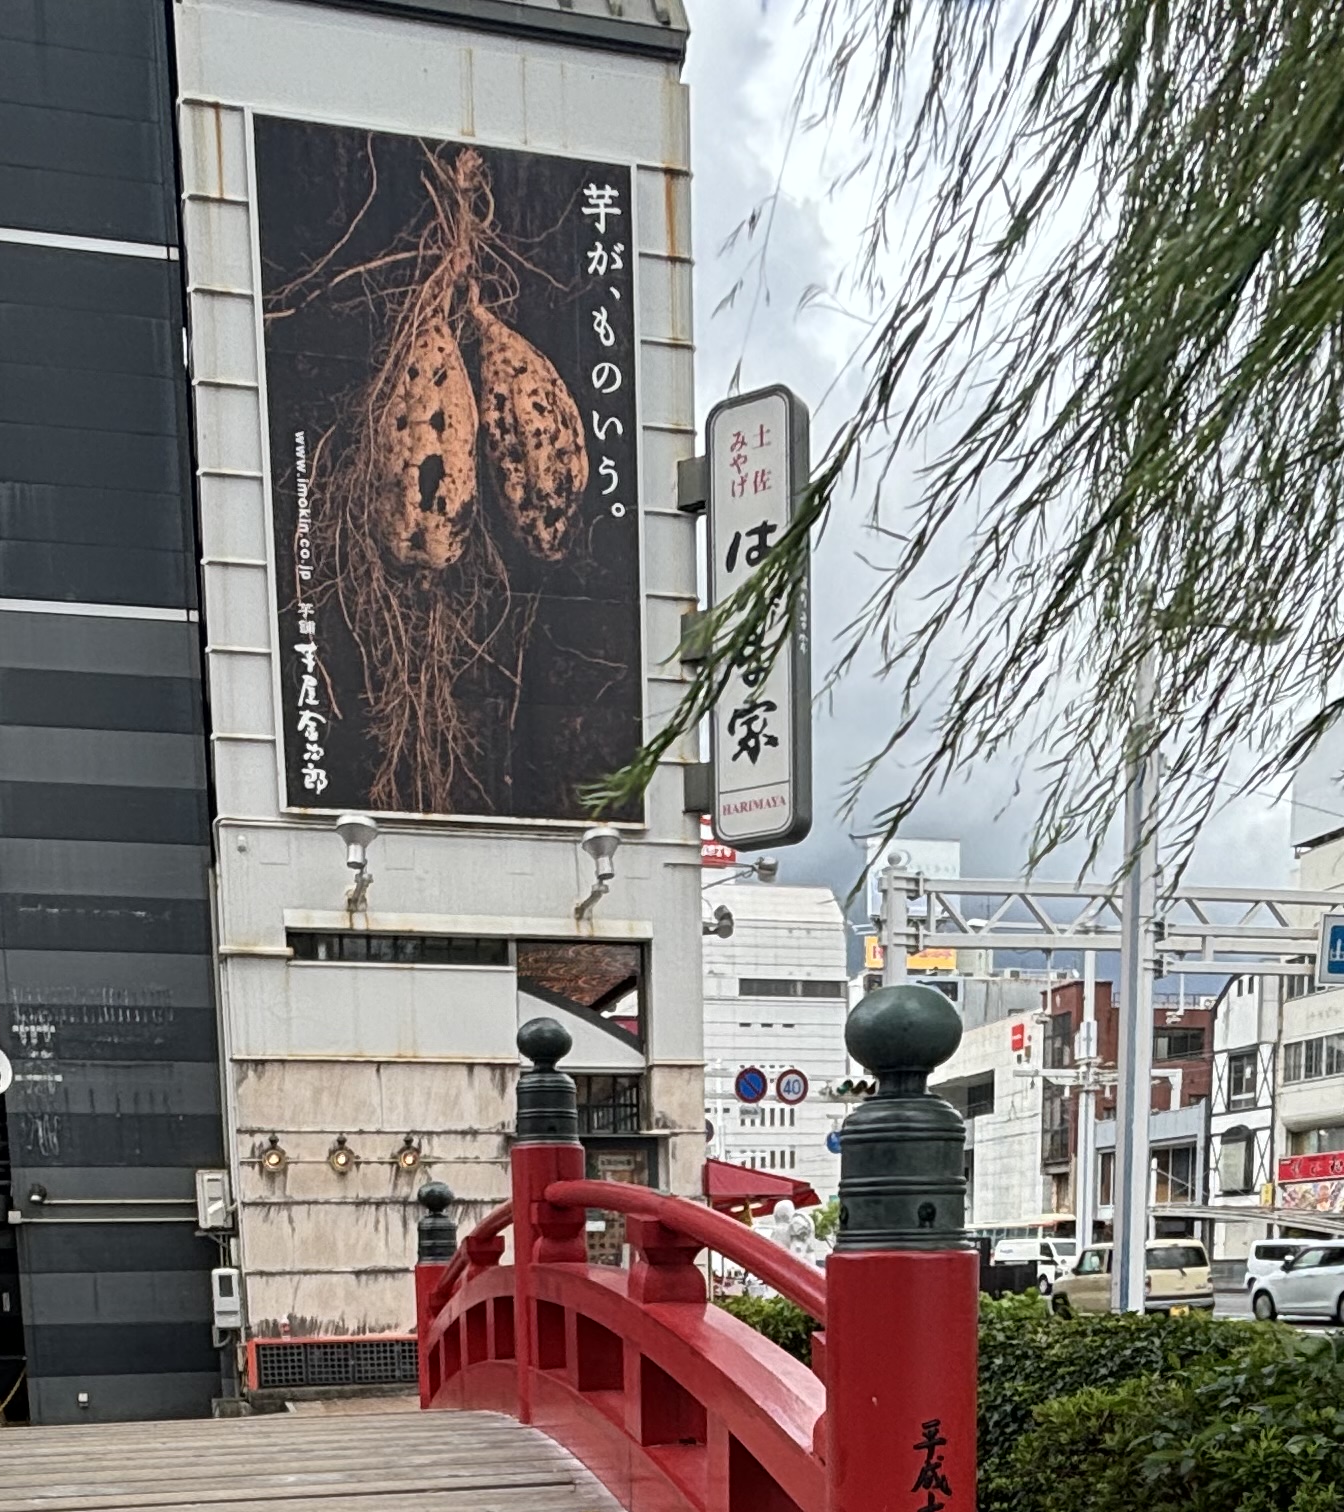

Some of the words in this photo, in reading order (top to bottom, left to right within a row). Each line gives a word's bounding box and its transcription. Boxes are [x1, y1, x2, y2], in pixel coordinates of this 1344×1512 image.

[581, 183, 625, 517] 芋が、ものいう。
[730, 430, 747, 499] みやげ
[752, 424, 772, 495] 土佐
[294, 431, 313, 581] www.imokin.co.jp
[726, 520, 779, 765] はま家
[722, 795, 787, 817] HARIMAYA
[783, 1079, 802, 1095] 40
